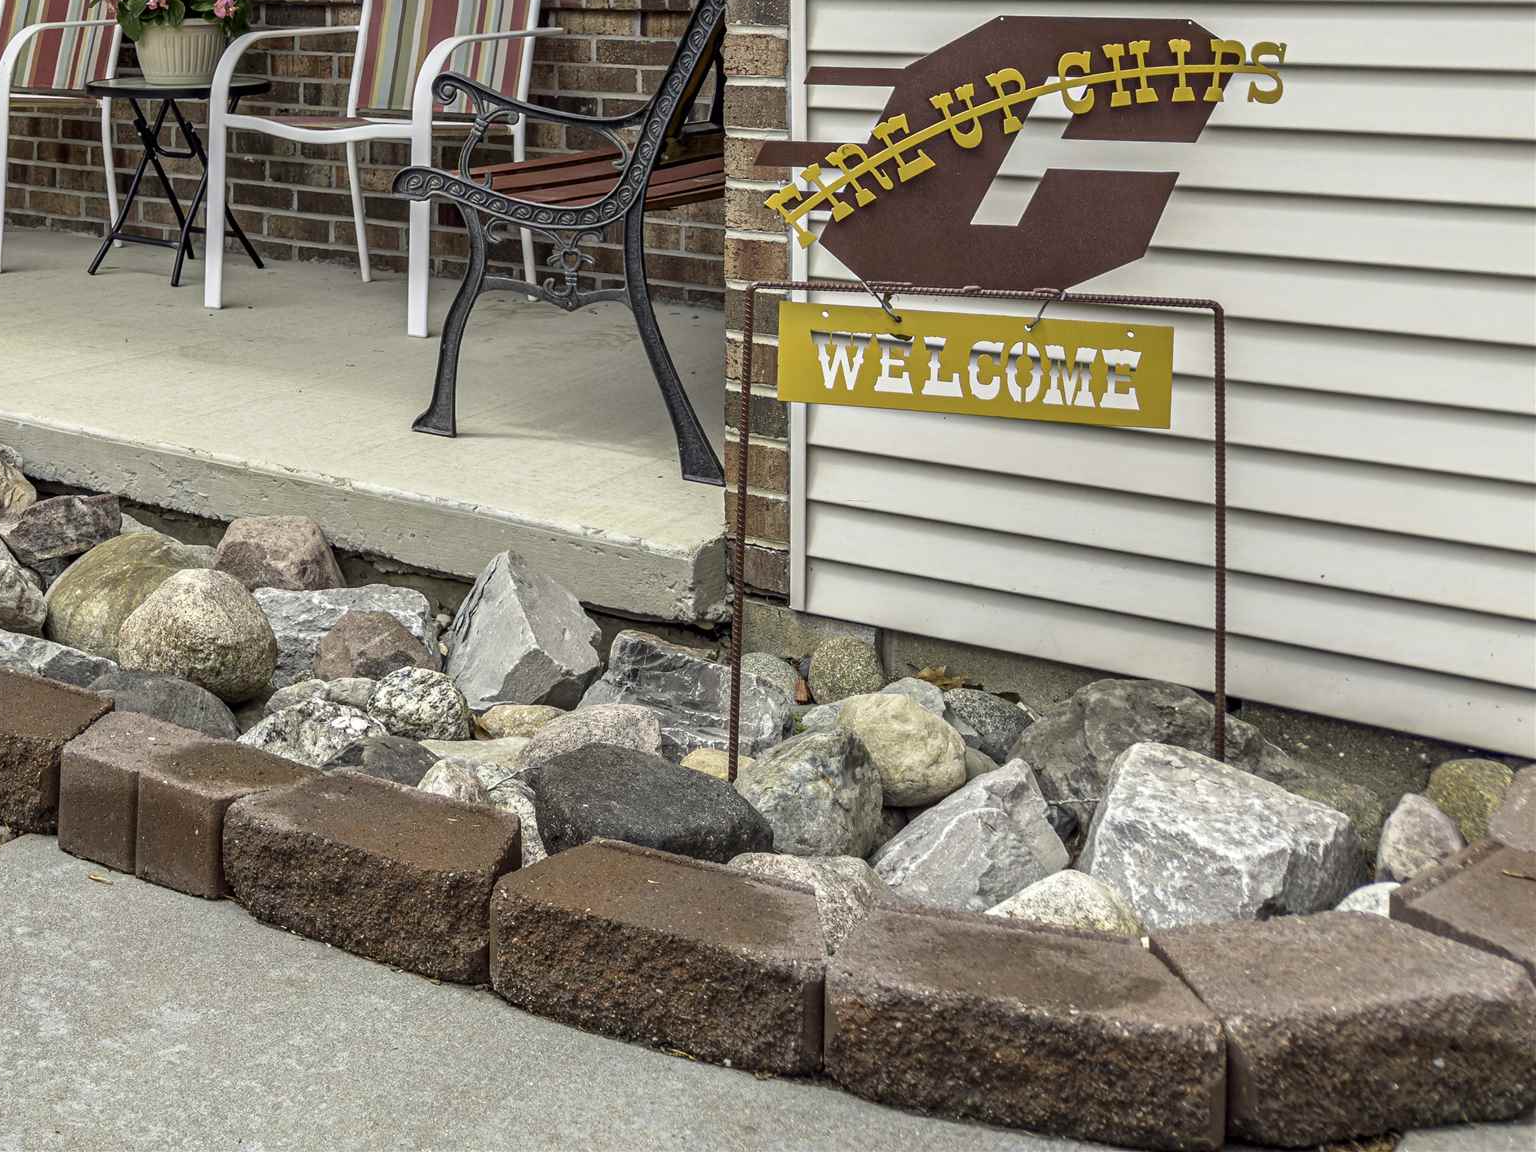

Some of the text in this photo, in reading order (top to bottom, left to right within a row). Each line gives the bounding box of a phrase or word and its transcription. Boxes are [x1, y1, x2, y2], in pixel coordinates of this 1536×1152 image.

[764, 39, 1288, 250] FIRE UP CHIPS
[810, 329, 1141, 410] WELCOME
